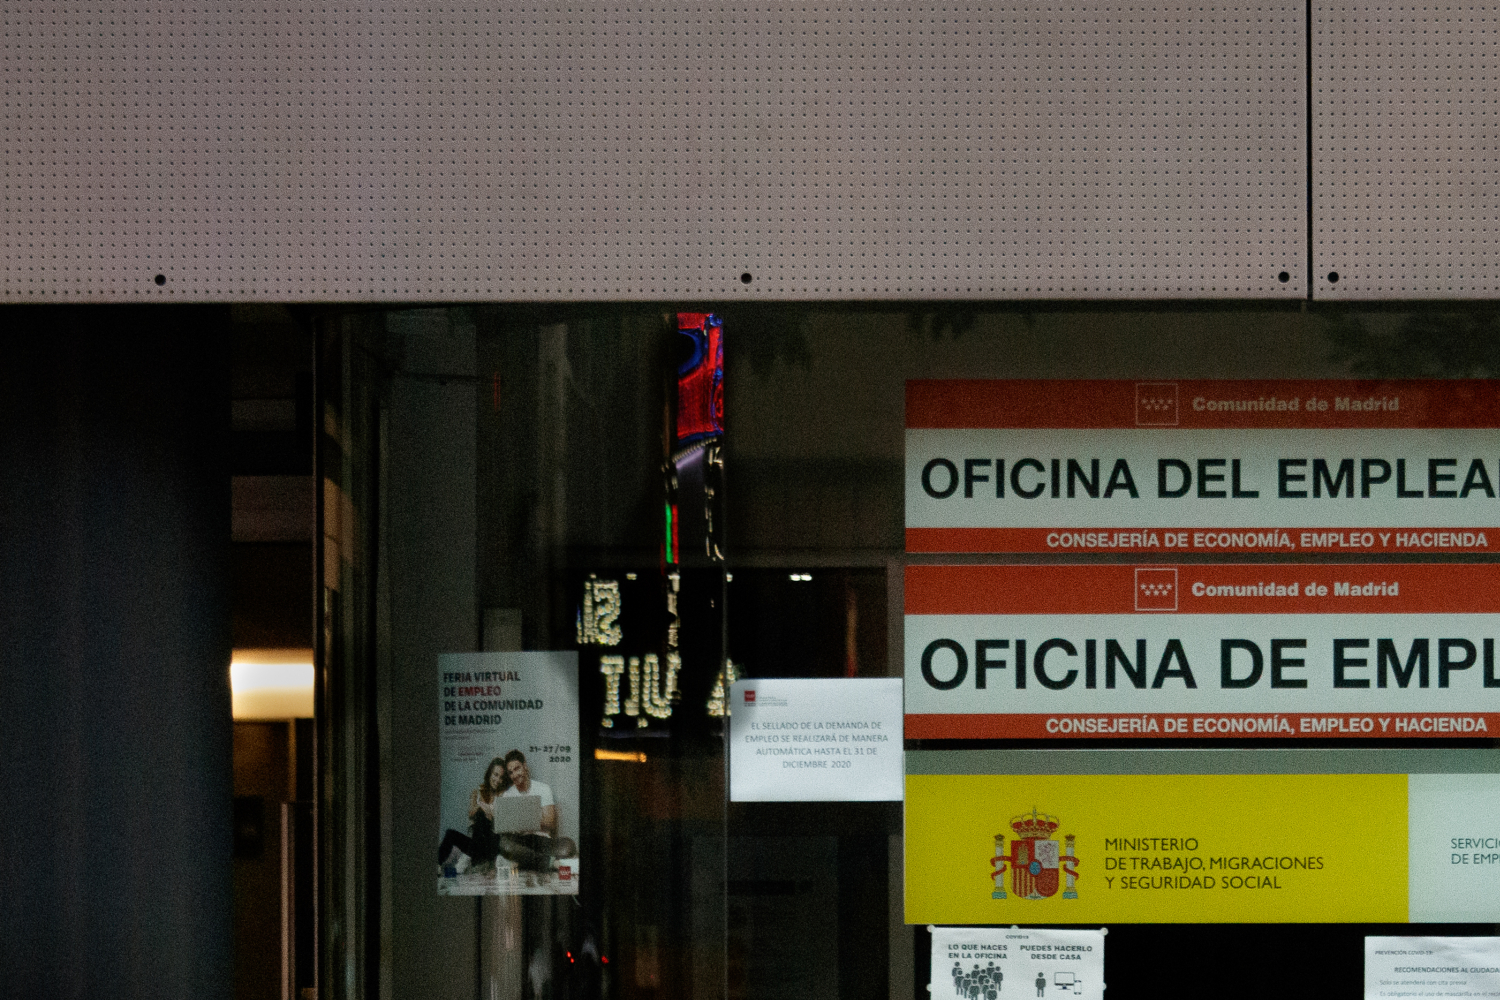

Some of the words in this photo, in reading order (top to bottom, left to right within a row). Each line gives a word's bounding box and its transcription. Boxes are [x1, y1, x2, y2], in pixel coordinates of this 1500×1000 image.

[1192, 397, 1299, 412] Comunidad
[1305, 397, 1329, 412] de
[1335, 397, 1399, 412] Madrid
[920, 458, 1140, 500] OFICINA
[1157, 458, 1259, 500] DEL
[1046, 531, 1157, 548] CONSEJERÍA
[1158, 533, 1188, 548] DE
[1193, 531, 1296, 550] ECONOMÍA,
[1300, 533, 1375, 548] EMPLEO
[1379, 533, 1391, 548] Y
[1396, 533, 1488, 548] HACIENDA
[1191, 582, 1299, 598] Comunidad
[1305, 582, 1329, 598] de
[1335, 582, 1399, 598] Madrid
[920, 638, 1197, 690] OFICINA
[1220, 638, 1308, 689] DE
[443, 672, 472, 682] FERIA
[474, 671, 520, 682] VIRTUAL
[444, 686, 456, 696] DE
[458, 686, 501, 696] EMPLEO
[445, 701, 457, 711] DE
[458, 701, 472, 711] LA
[473, 699, 543, 711] COMUNIDAD
[445, 715, 457, 725] DE
[459, 714, 502, 725] MADRID
[751, 722, 761, 730] EL
[762, 722, 798, 730] SELLADO
[871, 721, 881, 729] DE
[1046, 715, 1157, 733] CONSEJERÍA
[1158, 718, 1188, 732] DE
[1193, 715, 1296, 735] ECONOMÍA,
[1300, 718, 1375, 733] EMPLEO
[1379, 718, 1391, 732] Y
[1396, 718, 1488, 733] HACIENDA
[745, 735, 779, 743] EMPLEO
[781, 735, 790, 743] SE
[793, 734, 836, 742] REALIZARÁ
[852, 734, 888, 742] MANERA
[756, 747, 811, 755] AUTOMÁTICA
[854, 747, 864, 755] 31
[867, 747, 877, 755] DE
[549, 755, 571, 763] 2020
[783, 761, 827, 769] DICIEMBRE
[831, 760, 851, 769] 2020
[1105, 837, 1199, 851] MINISTERIO
[1105, 857, 1126, 869] DE
[1129, 856, 1206, 872] TRABAJO,
[1210, 856, 1324, 869] MIGRACIONES
[1450, 853, 1468, 864] DE
[1105, 876, 1116, 889] Y
[1120, 875, 1216, 890] SEGURIDAD
[1221, 875, 1283, 889] SOCIAL
